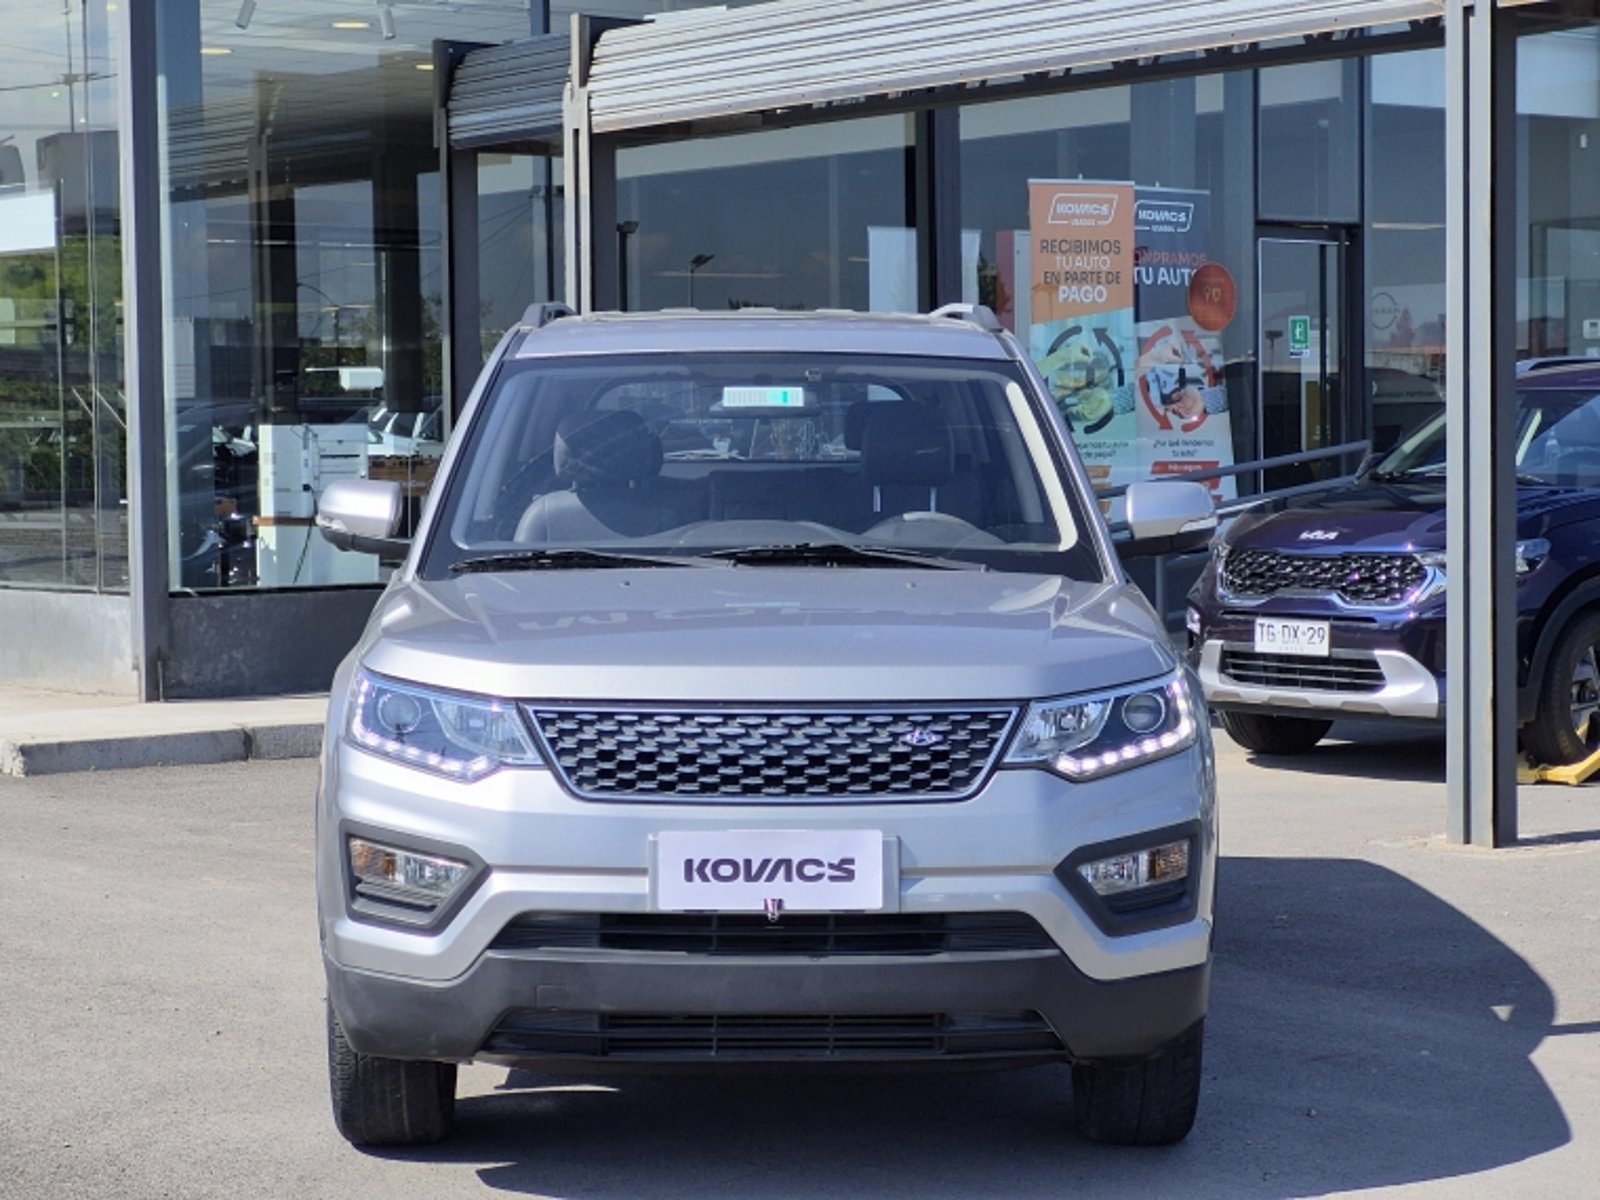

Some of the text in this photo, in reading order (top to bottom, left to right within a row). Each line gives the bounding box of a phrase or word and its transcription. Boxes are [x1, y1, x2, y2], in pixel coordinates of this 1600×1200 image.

[1039, 239, 1121, 255] RECIBIMOS
[1055, 255, 1111, 271] TU AUTO
[1043, 271, 1121, 285] EN PARTE DE
[1157, 266, 1197, 287] AUT
[1058, 285, 1108, 304] PAGO
[683, 858, 856, 883] KOVACS
